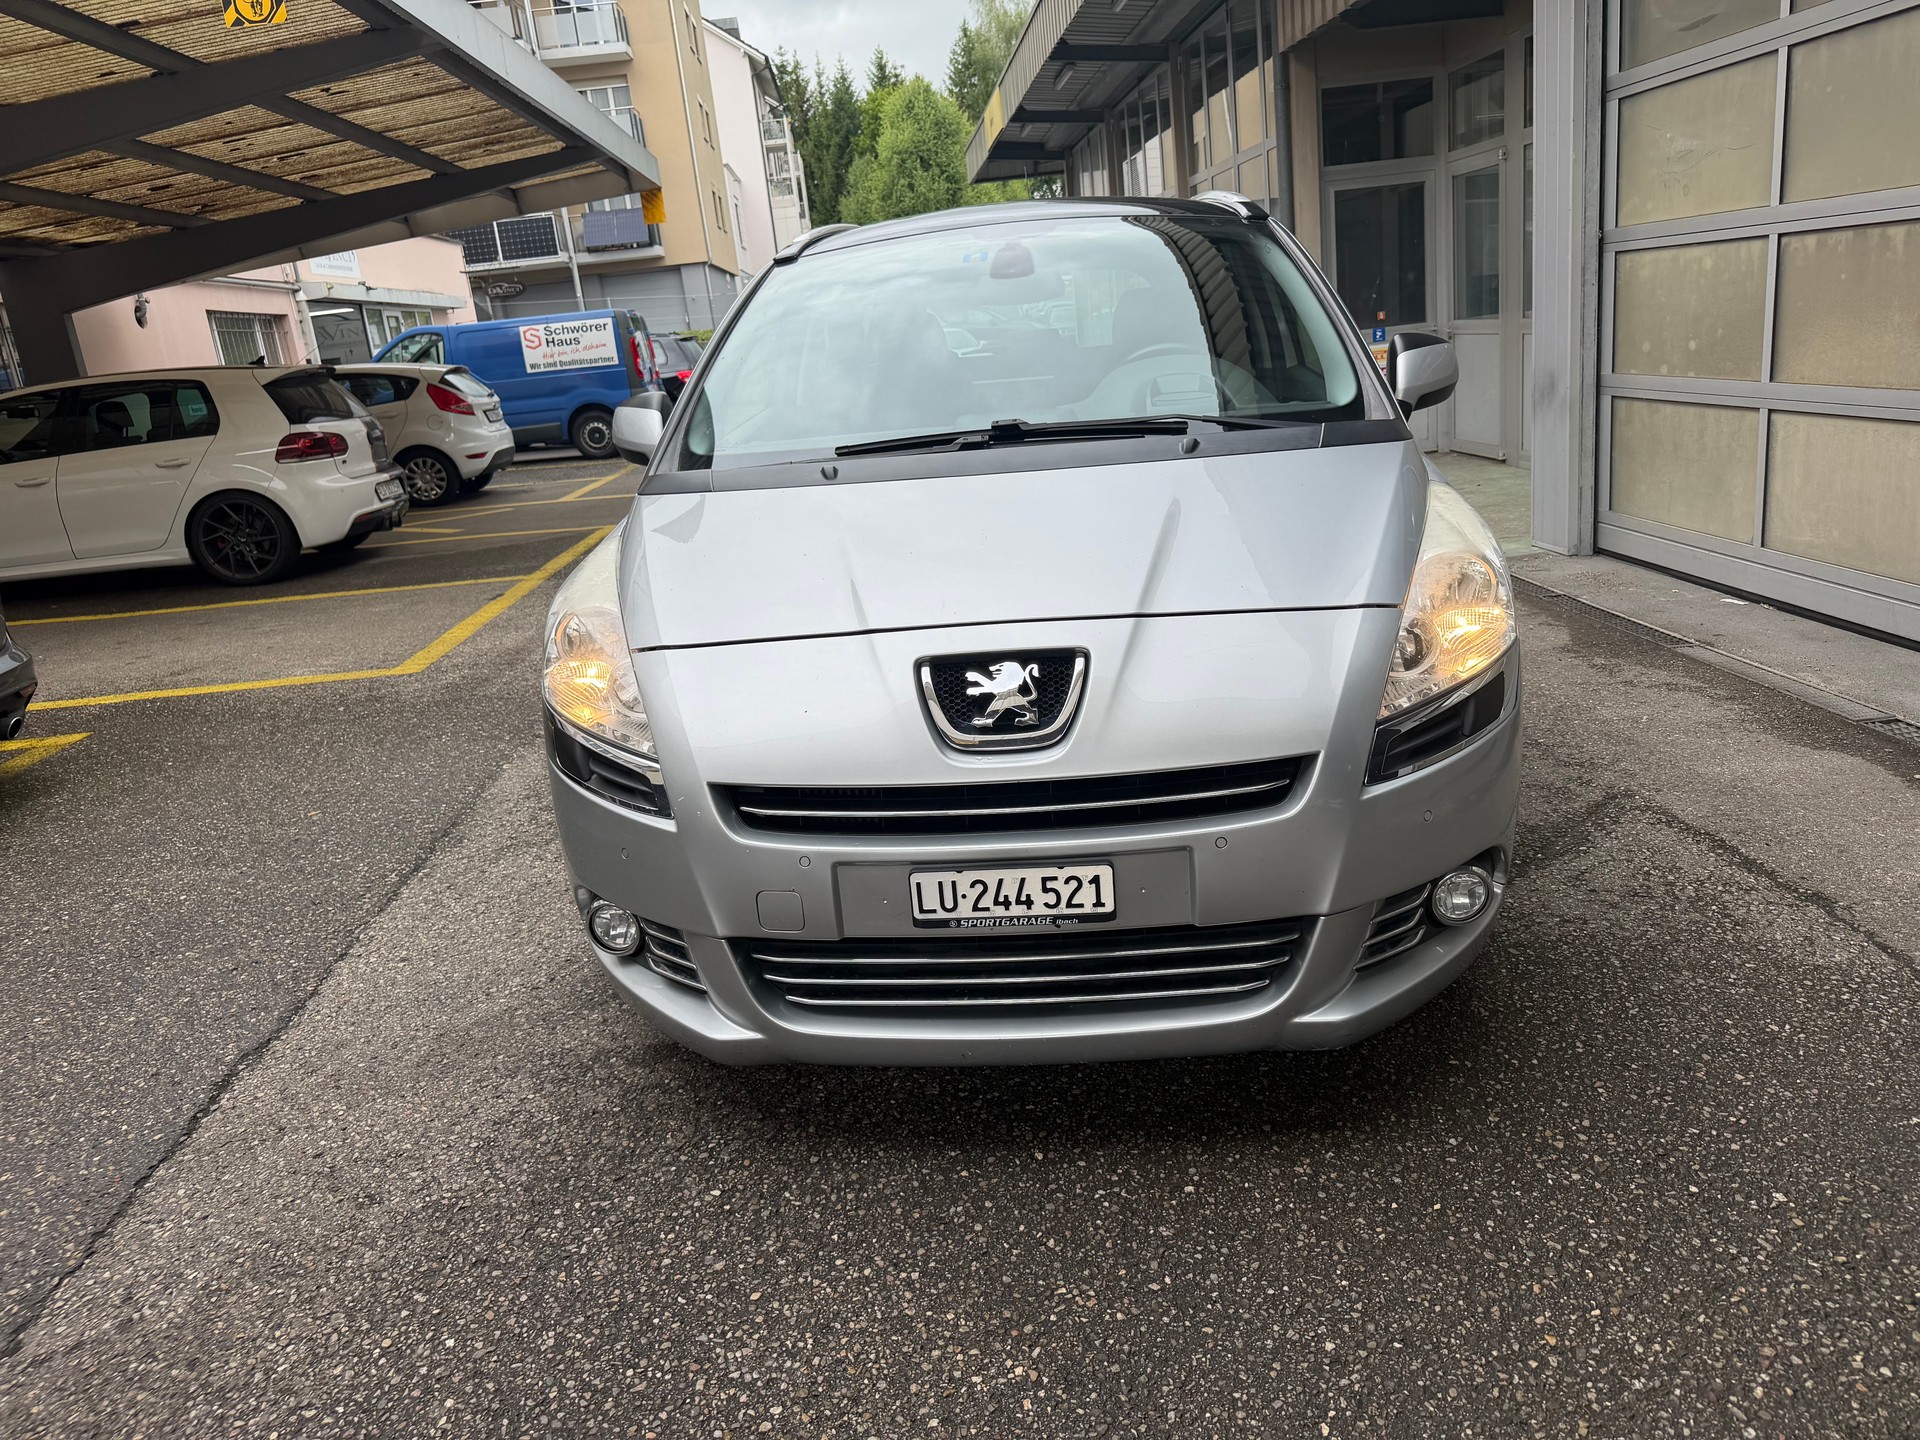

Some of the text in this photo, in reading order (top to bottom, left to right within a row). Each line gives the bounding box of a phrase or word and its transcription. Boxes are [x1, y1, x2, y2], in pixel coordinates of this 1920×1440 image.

[543, 322, 608, 337] Schwörer
[545, 336, 581, 348] Haus
[543, 351, 556, 361] Hier
[529, 363, 542, 371] Wir
[542, 360, 558, 369] sind
[960, 916, 1053, 928] SPORTGARAGE
